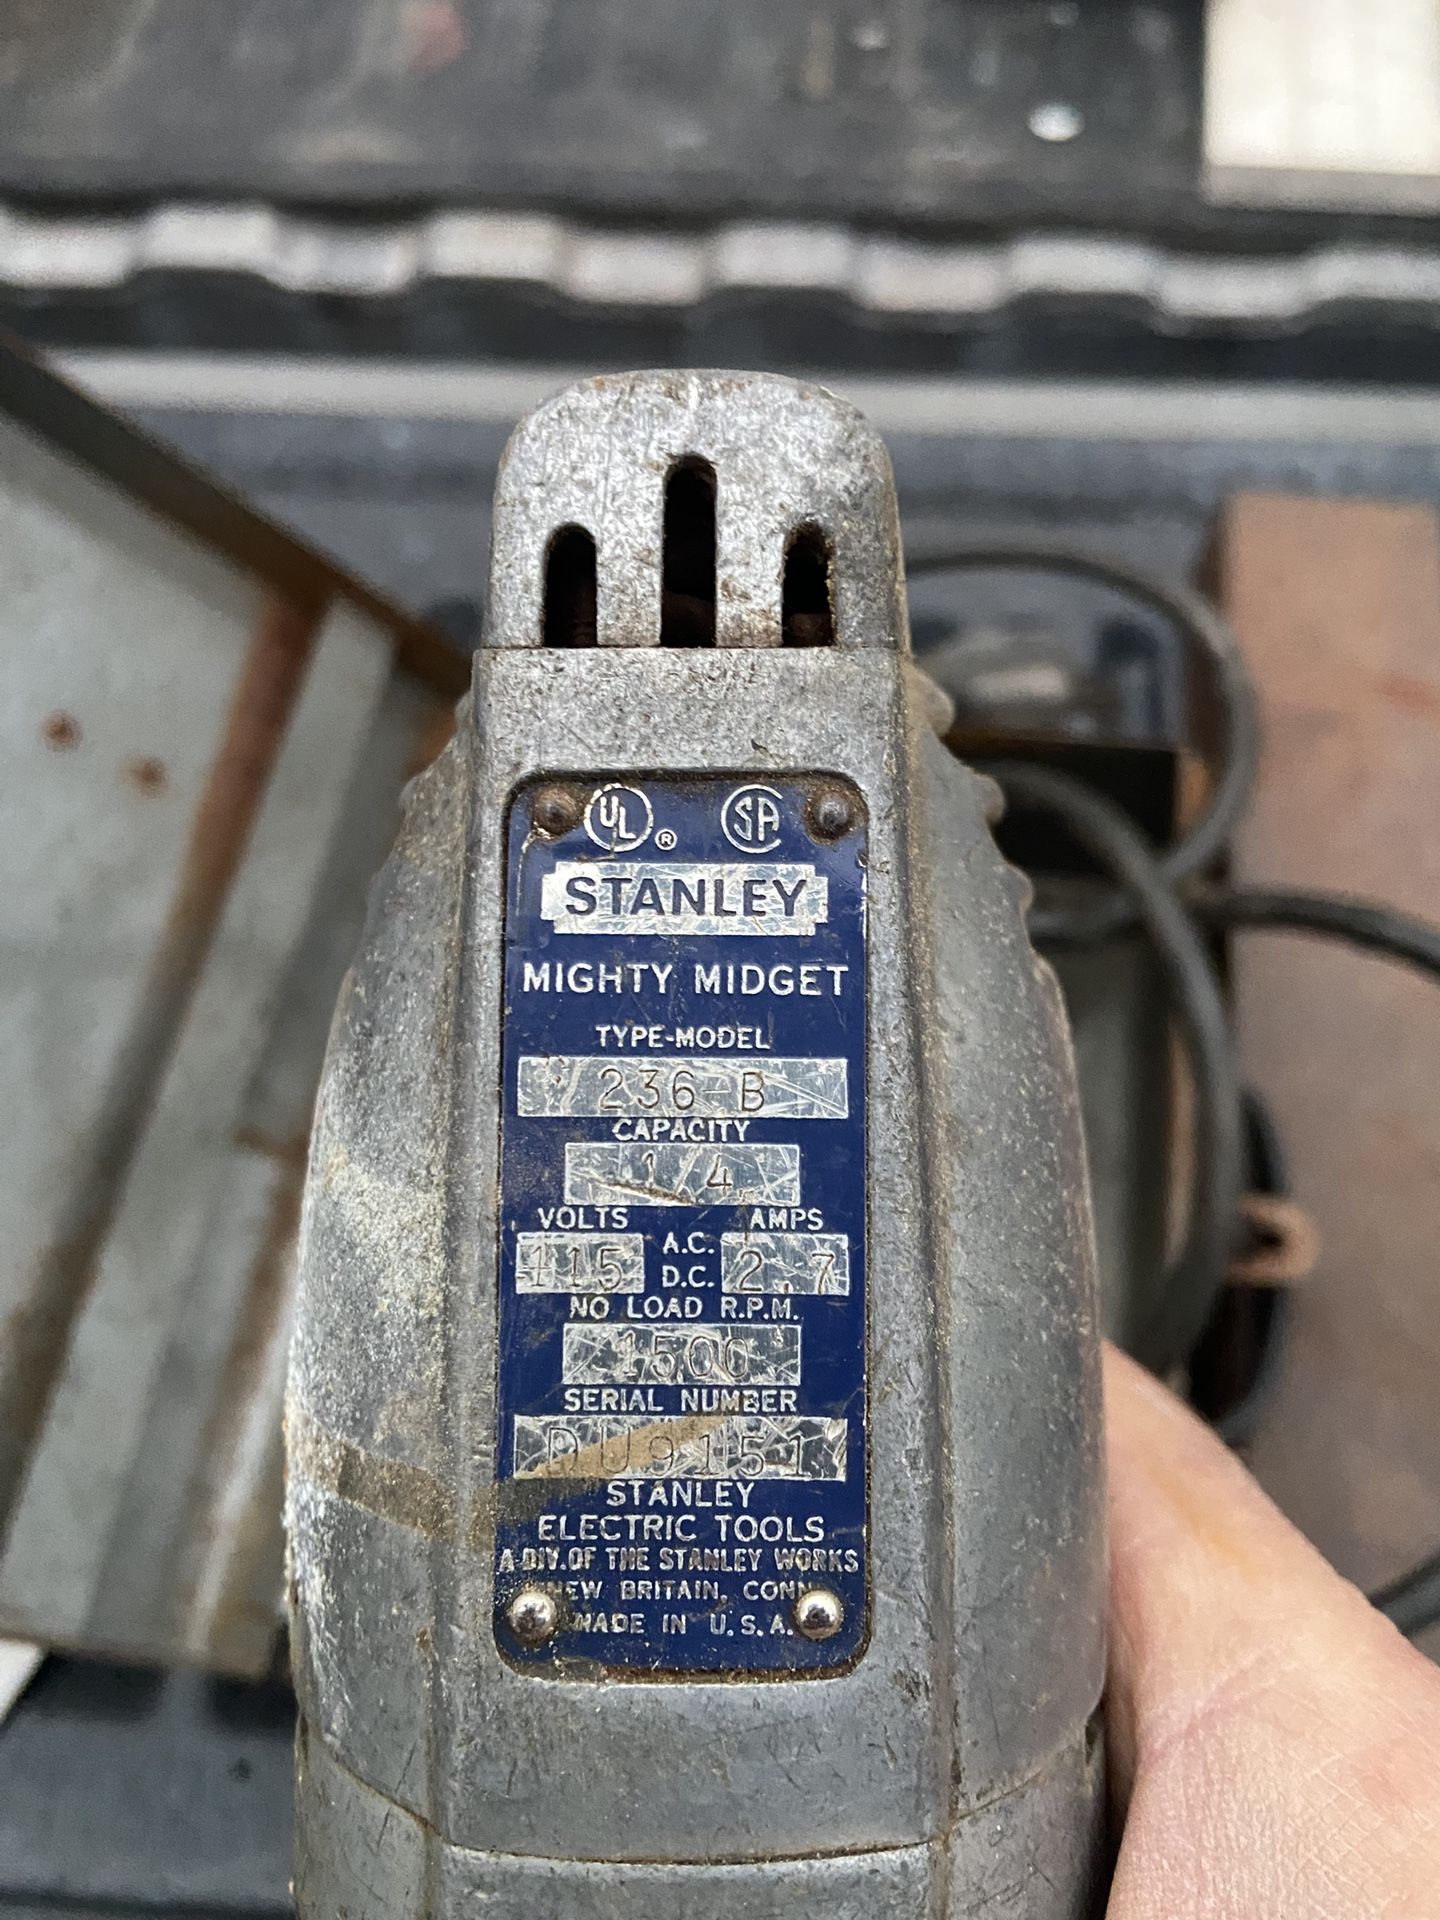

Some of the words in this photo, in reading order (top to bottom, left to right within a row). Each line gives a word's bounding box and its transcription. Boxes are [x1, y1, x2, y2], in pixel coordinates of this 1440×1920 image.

[565, 876, 807, 918] STANLEY
[523, 963, 673, 994] MIGHTY
[695, 964, 849, 996] MIDGET
[596, 1026, 771, 1050] TYPE-MODEL
[612, 1119, 751, 1142] CAPACITY
[537, 1207, 629, 1230] VOLTS
[749, 1208, 824, 1231] AMPS
[662, 1232, 715, 1255] A.C.
[530, 1245, 625, 1292] 115
[662, 1265, 715, 1289] D.C.
[738, 1249, 836, 1296] 2.7
[569, 1297, 610, 1319] NO
[627, 1296, 703, 1319] LOAD
[720, 1297, 800, 1320] R.P.M.
[622, 1330, 750, 1379] 1500
[564, 1389, 664, 1412] SERIAL
[681, 1389, 797, 1412] NUMBER
[606, 1480, 755, 1508] STANLEY
[538, 1514, 697, 1541] ELECTRIC
[714, 1516, 826, 1542] TOOLS
[499, 1549, 514, 1572] A
[605, 1547, 651, 1571] THE
[659, 1547, 763, 1572] STANLEY
[774, 1547, 860, 1573] WORKS
[573, 1613, 645, 1635] MADE
[662, 1614, 687, 1635] IN
